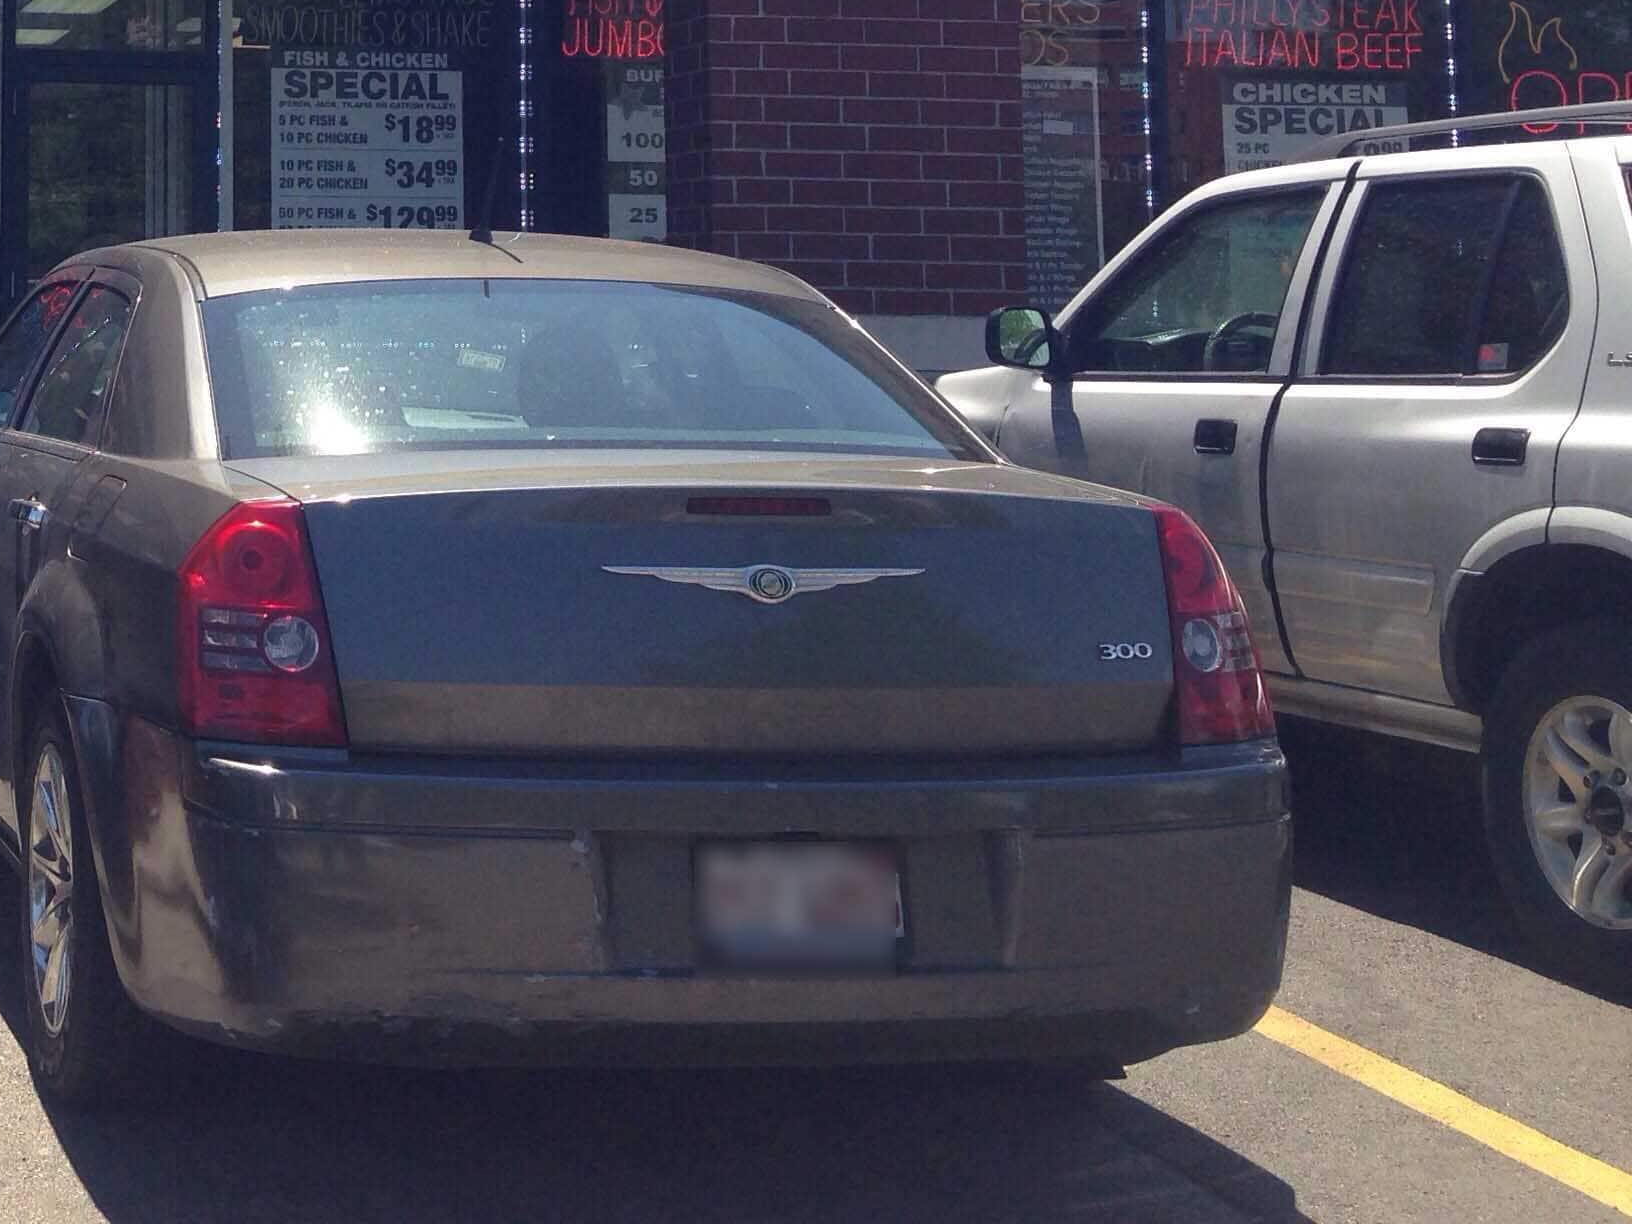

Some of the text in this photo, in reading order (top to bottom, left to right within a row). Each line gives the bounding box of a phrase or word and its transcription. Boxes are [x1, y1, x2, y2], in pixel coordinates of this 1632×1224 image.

[1184, 27, 1424, 70] ITALIAN BEEF
[283, 50, 448, 68] FISH & CHICKEN
[283, 69, 450, 101] SPECIAL
[1232, 81, 1387, 104] CHICKEN
[290, 115, 305, 126] PC
[309, 114, 336, 126] FISH
[338, 115, 348, 126] &
[280, 132, 368, 145] 10 PC CHICKEN
[622, 131, 663, 149] 100
[1254, 143, 1270, 154] PC
[280, 159, 356, 172] 10 PC FISH &
[279, 177, 368, 190] 20 PC CHICKEN
[629, 169, 658, 186] 50
[297, 207, 313, 219] PC
[317, 207, 344, 220] FISH
[347, 208, 357, 220] &
[629, 207, 658, 223] 25
[1098, 641, 1153, 660] 300
